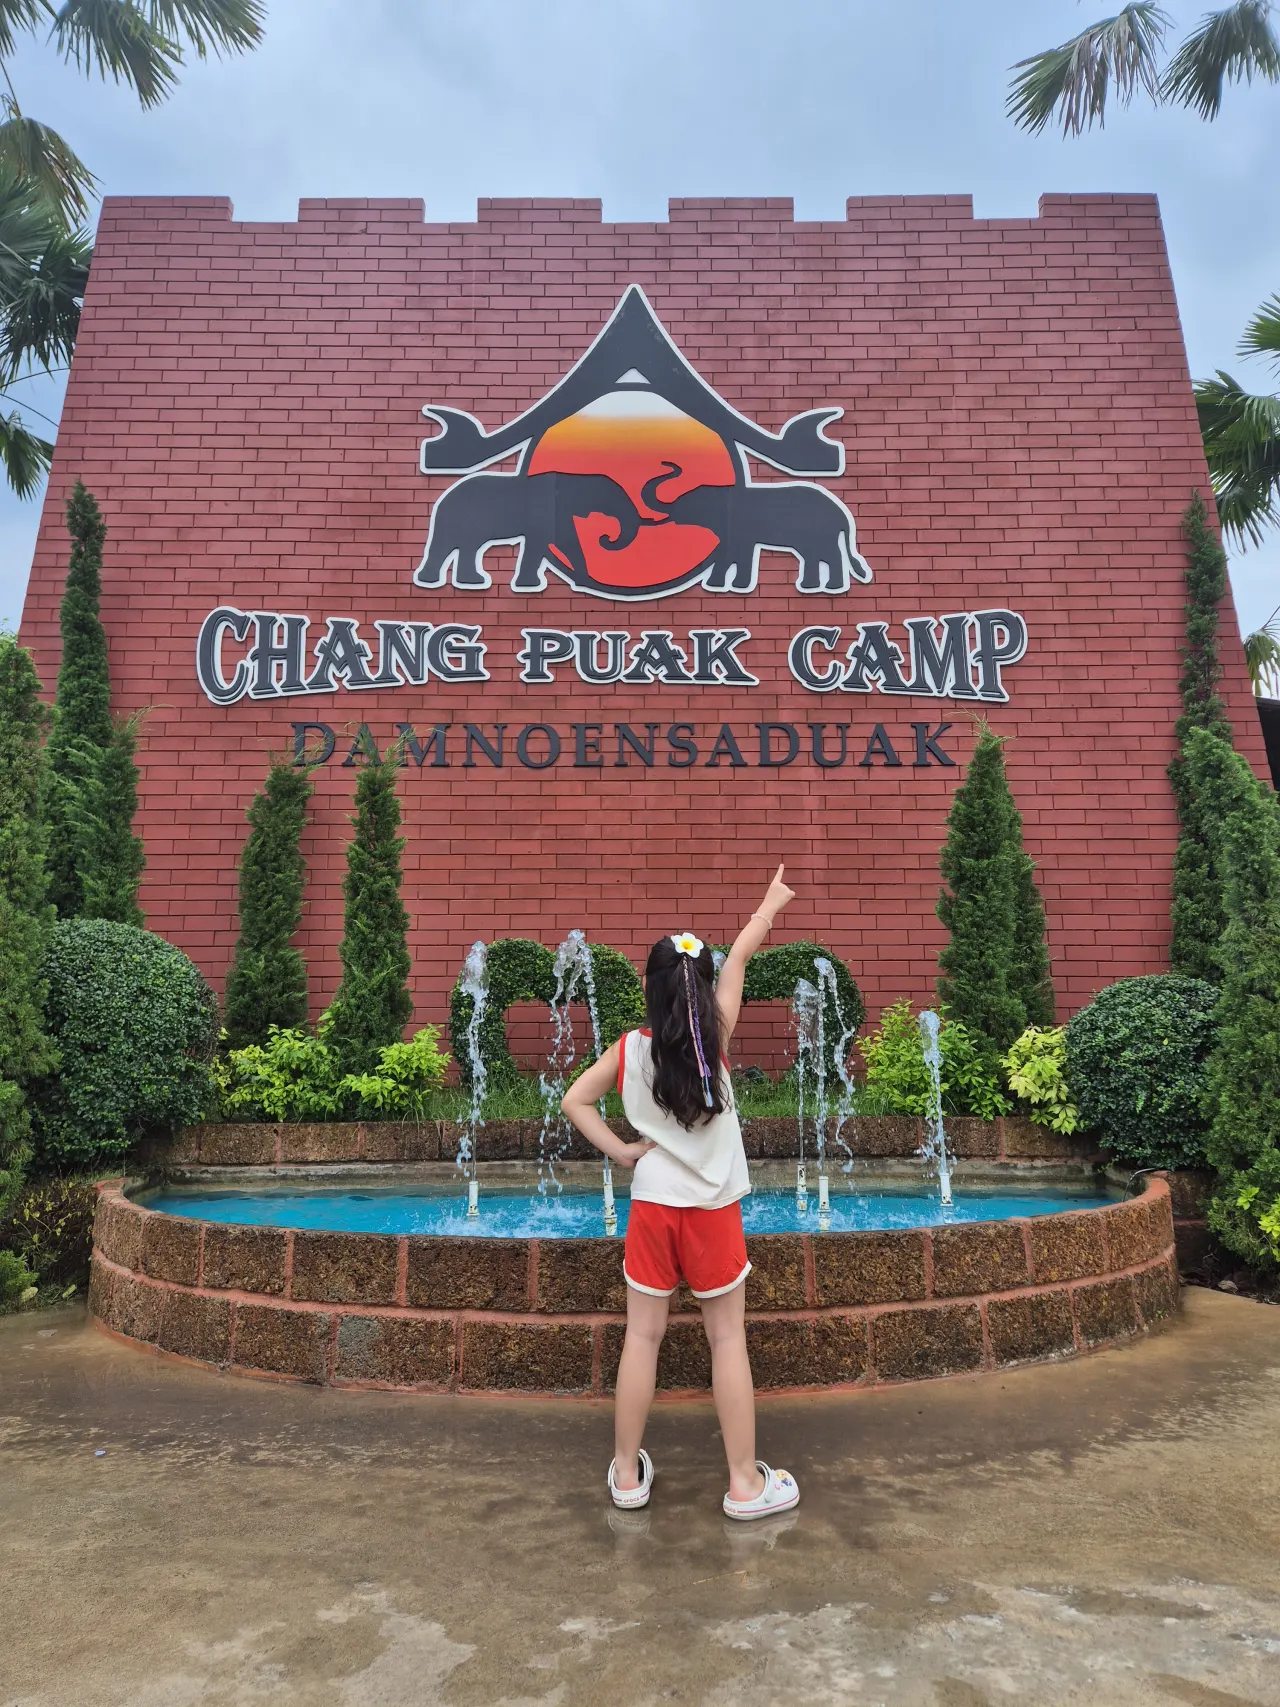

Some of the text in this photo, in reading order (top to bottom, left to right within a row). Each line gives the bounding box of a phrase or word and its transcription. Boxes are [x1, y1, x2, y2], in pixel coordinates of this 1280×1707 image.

[197, 606, 1028, 705] CHANG PUAK CAMP
[291, 721, 956, 768] DAMNOENSADUAK
